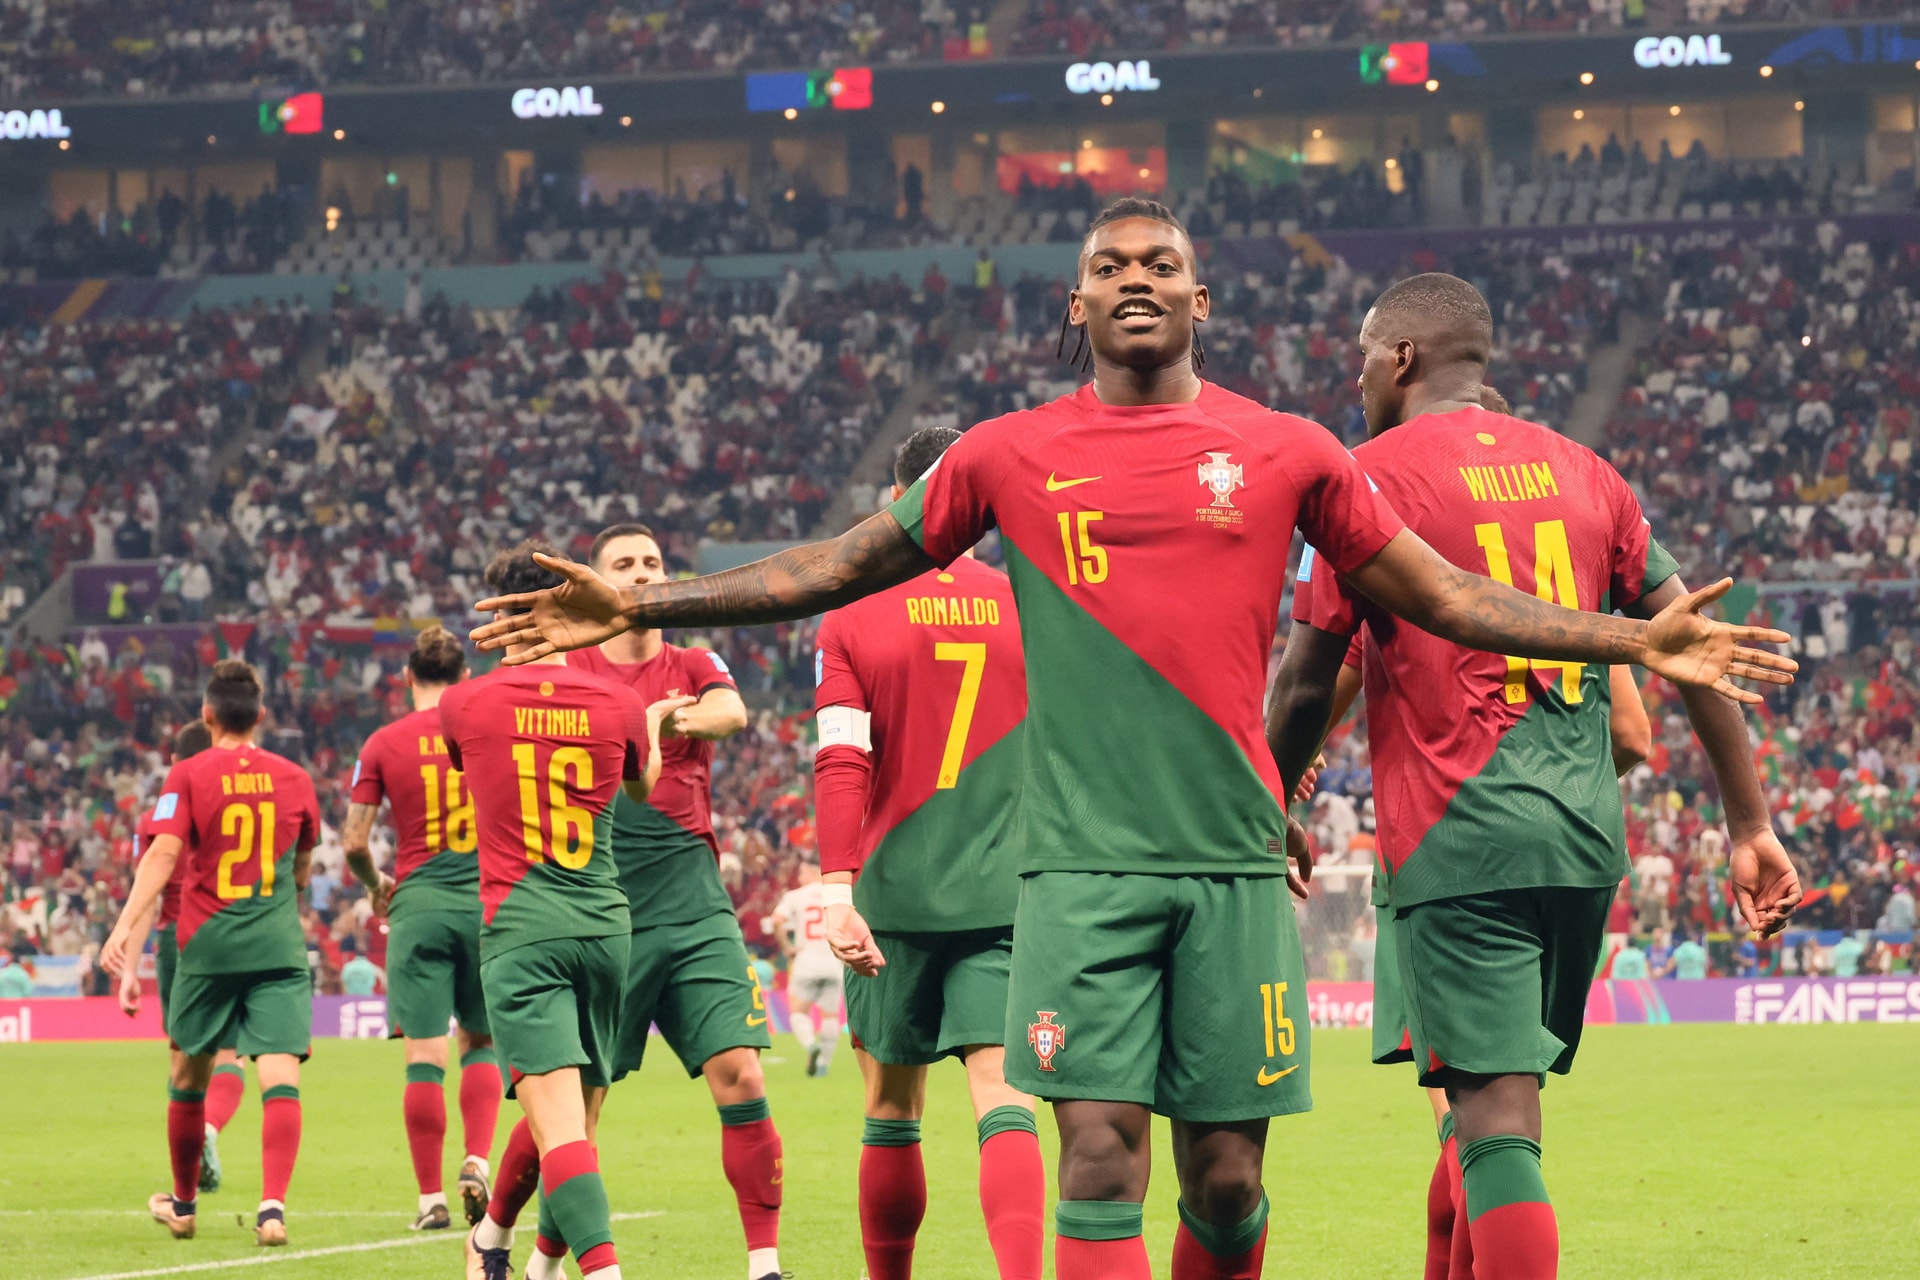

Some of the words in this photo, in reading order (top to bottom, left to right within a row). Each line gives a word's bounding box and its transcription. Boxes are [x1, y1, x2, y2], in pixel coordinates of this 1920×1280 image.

[1065, 60, 1160, 94] GOAL
[1633, 34, 1732, 68] GOAL
[0, 108, 71, 140] OAL
[511, 85, 603, 119] GOAL
[1459, 462, 1559, 501] WILLIAM
[1057, 510, 1108, 585] 15
[906, 597, 1000, 626] RONALDO
[1474, 520, 1588, 704] 14
[514, 707, 590, 737] VITINHA
[935, 642, 986, 789] 7
[421, 764, 478, 854] 18
[512, 743, 594, 870] 16
[217, 801, 275, 899] 21
[1260, 982, 1296, 1058] 15
